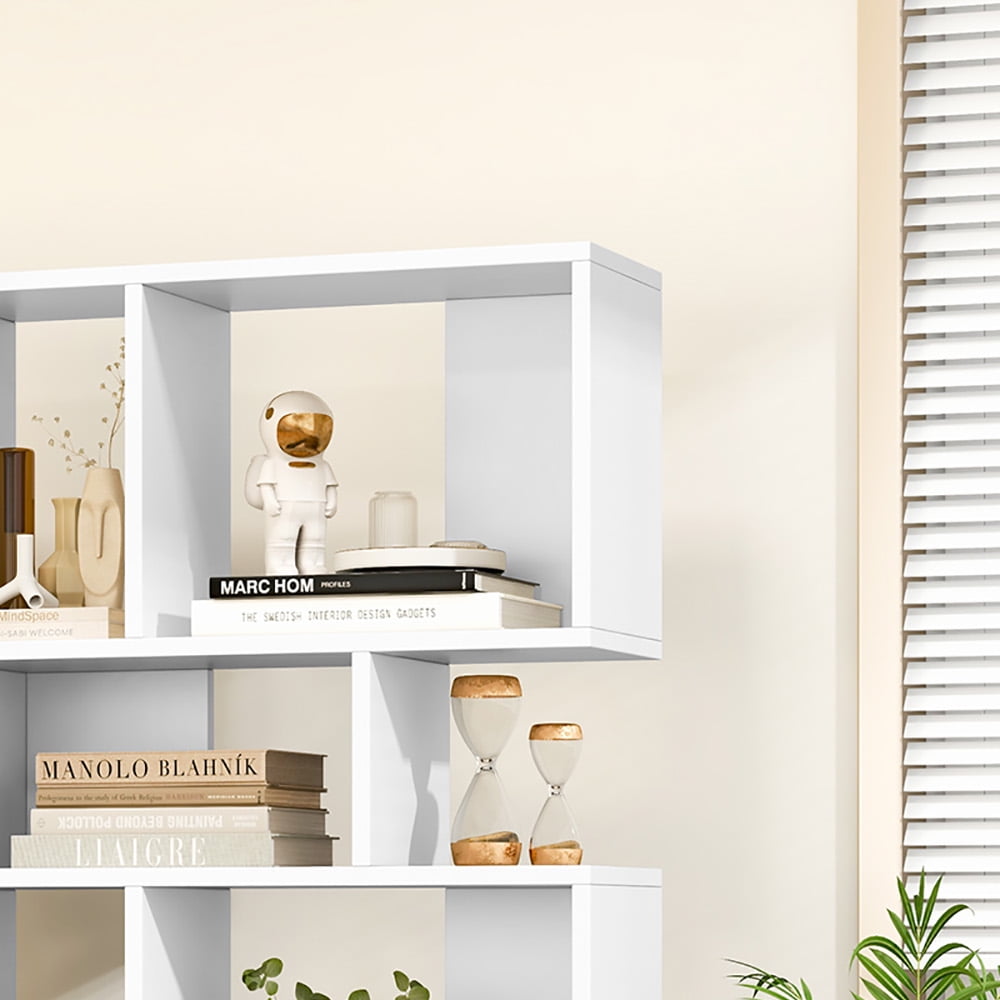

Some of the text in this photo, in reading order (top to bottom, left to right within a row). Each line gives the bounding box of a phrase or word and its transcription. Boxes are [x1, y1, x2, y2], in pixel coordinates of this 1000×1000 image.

[220, 579, 270, 595] MARC
[275, 578, 314, 593] HOM
[241, 608, 436, 622] THE SWEDISH INTERIOR DESIGN GADGETS
[29, 629, 73, 638] WELCOME
[42, 753, 257, 780] MANOLO BLAHNÍK
[58, 816, 111, 829] POLLOCK
[116, 815, 162, 829] BEYOND
[168, 815, 223, 828] PAINTING
[76, 836, 206, 867] LIAIGRE
